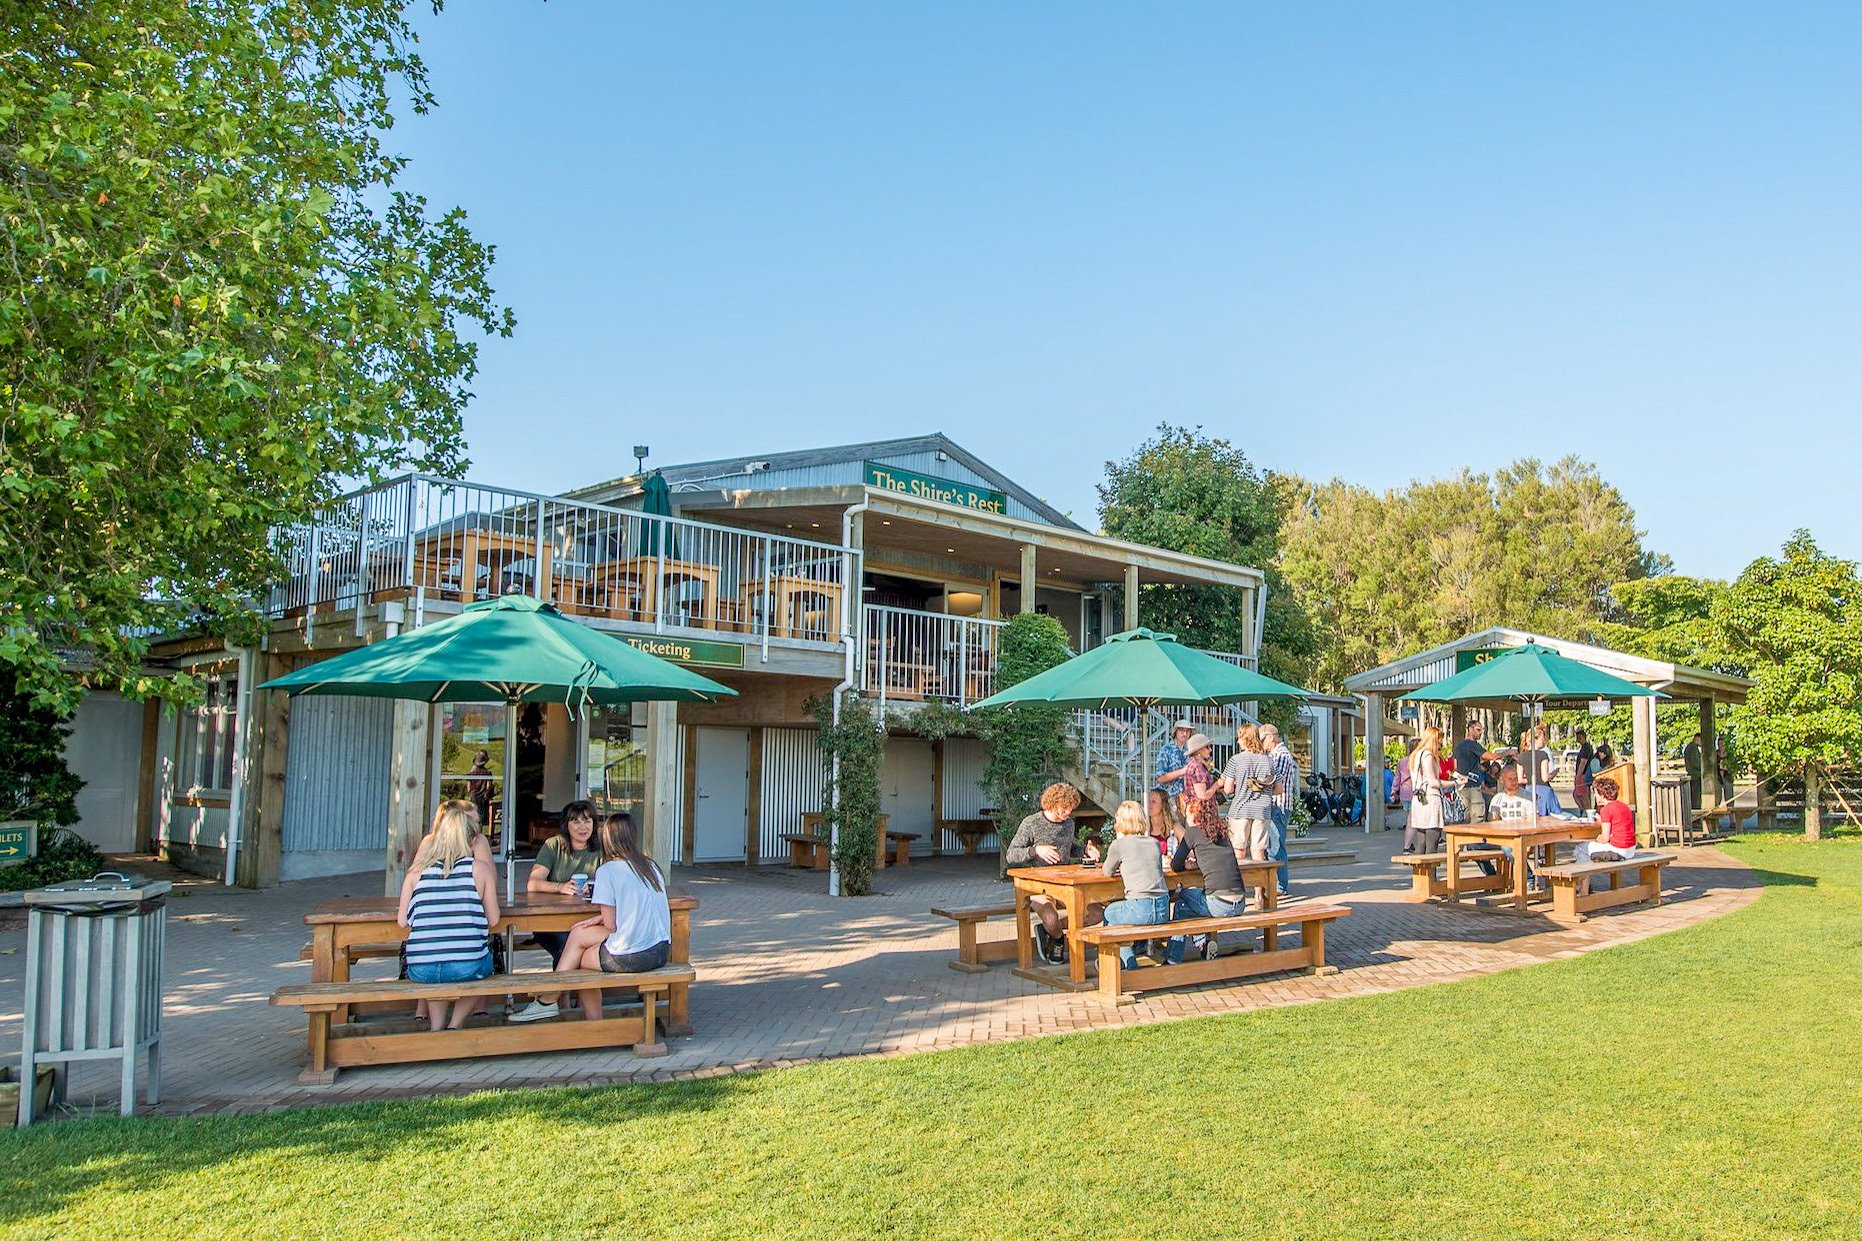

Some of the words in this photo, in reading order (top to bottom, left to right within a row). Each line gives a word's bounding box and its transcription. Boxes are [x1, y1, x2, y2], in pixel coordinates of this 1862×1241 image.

[872, 470, 906, 493] The
[910, 479, 964, 506] Shire's
[968, 492, 1002, 514] Rest
[627, 638, 691, 659] Ticketing
[1545, 700, 1561, 708] Tour
